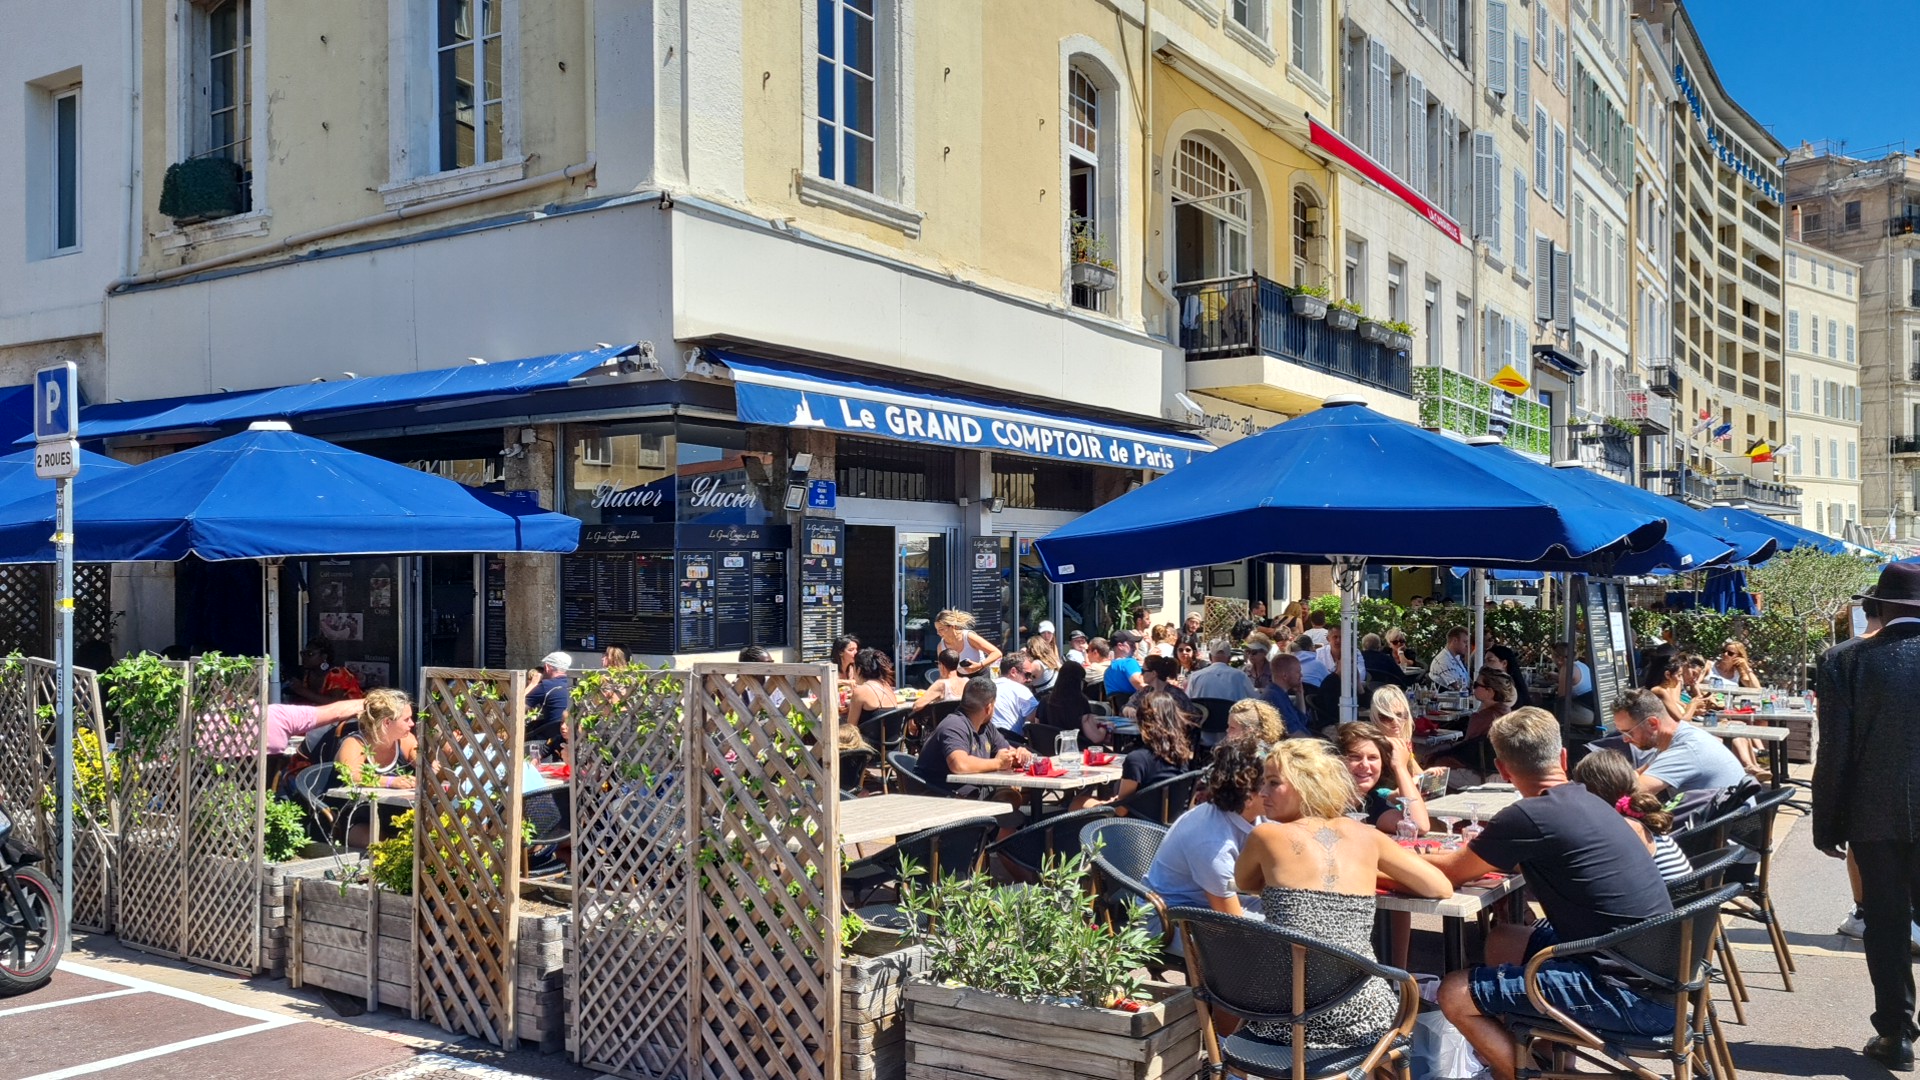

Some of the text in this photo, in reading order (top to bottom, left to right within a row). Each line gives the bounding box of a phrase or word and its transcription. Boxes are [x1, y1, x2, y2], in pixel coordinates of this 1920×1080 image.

[46, 380, 61, 425] P
[839, 399, 1174, 469] Le GRAND COMPTOIR de Paris
[37, 451, 71, 468] 2 ROUES
[590, 478, 663, 509] Glacier
[690, 476, 759, 509] Glacier
